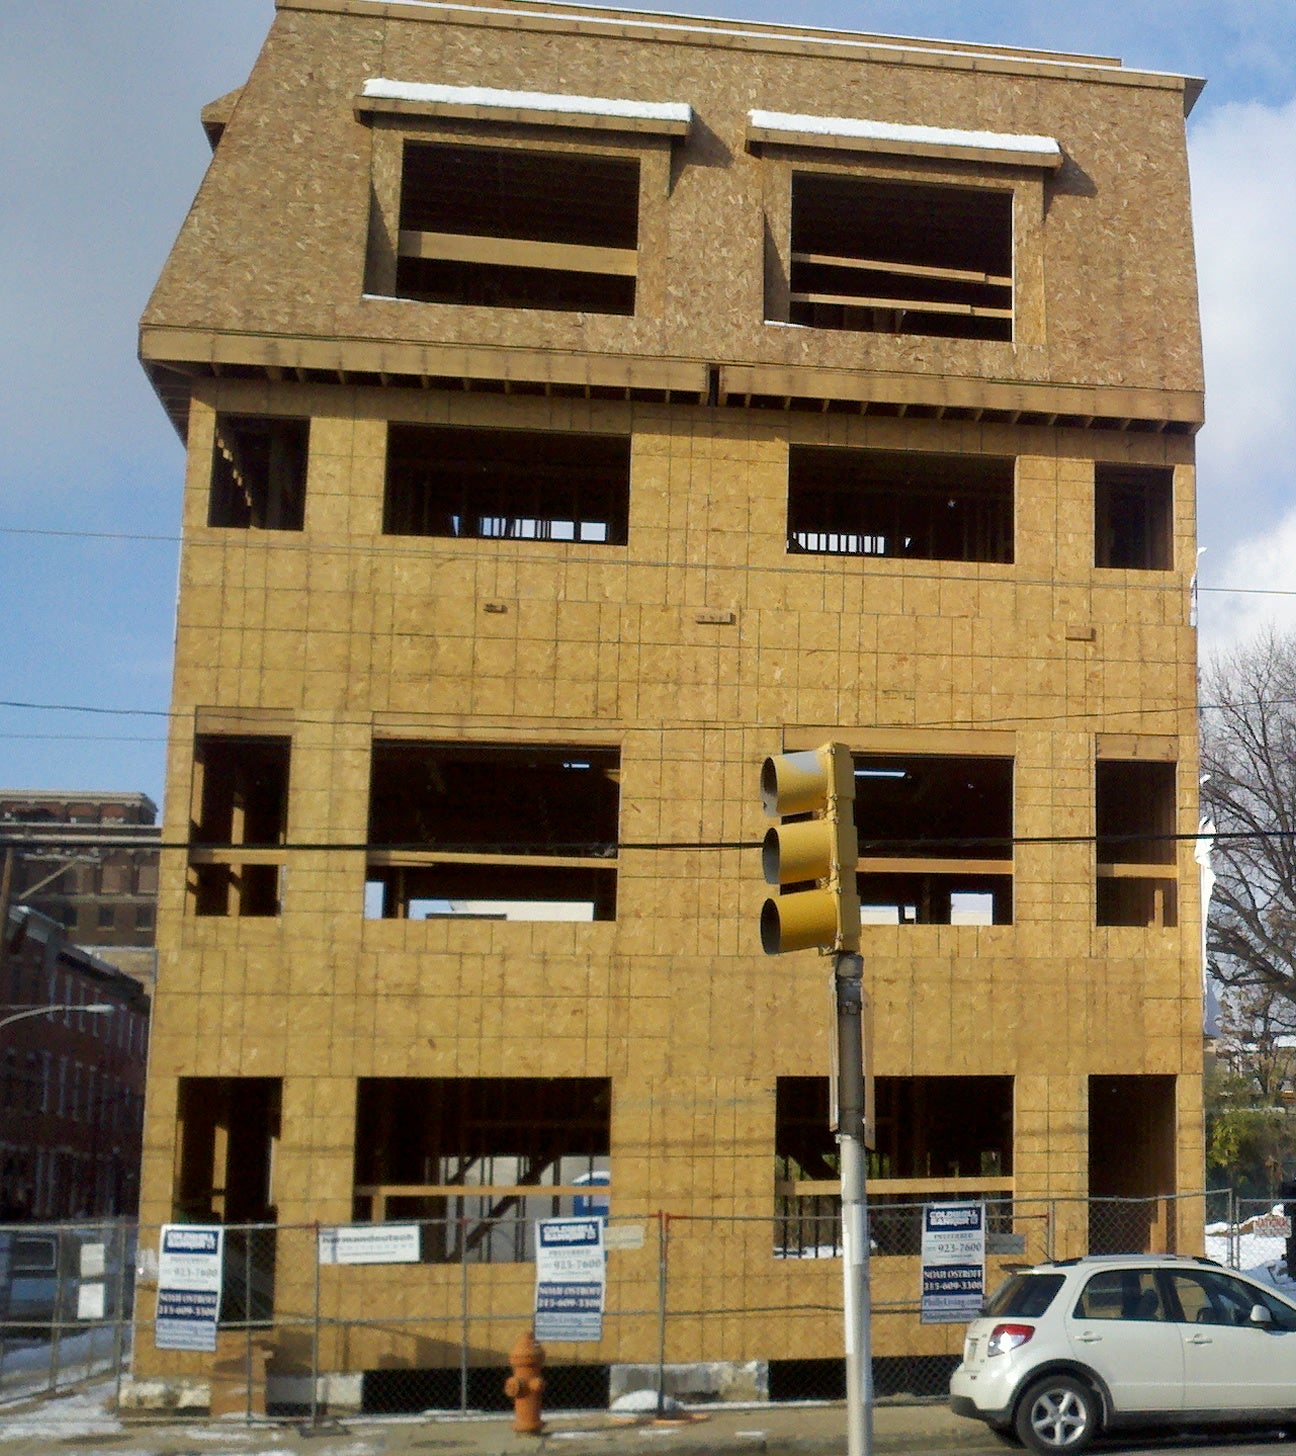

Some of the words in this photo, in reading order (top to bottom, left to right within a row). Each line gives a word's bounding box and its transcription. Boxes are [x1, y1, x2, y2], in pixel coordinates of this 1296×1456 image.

[929, 1209, 977, 1219] COLDWELL
[938, 1243, 981, 1253] 923-7600
[553, 1259, 602, 1269] 923-7600
[924, 1270, 947, 1279] NOAH
